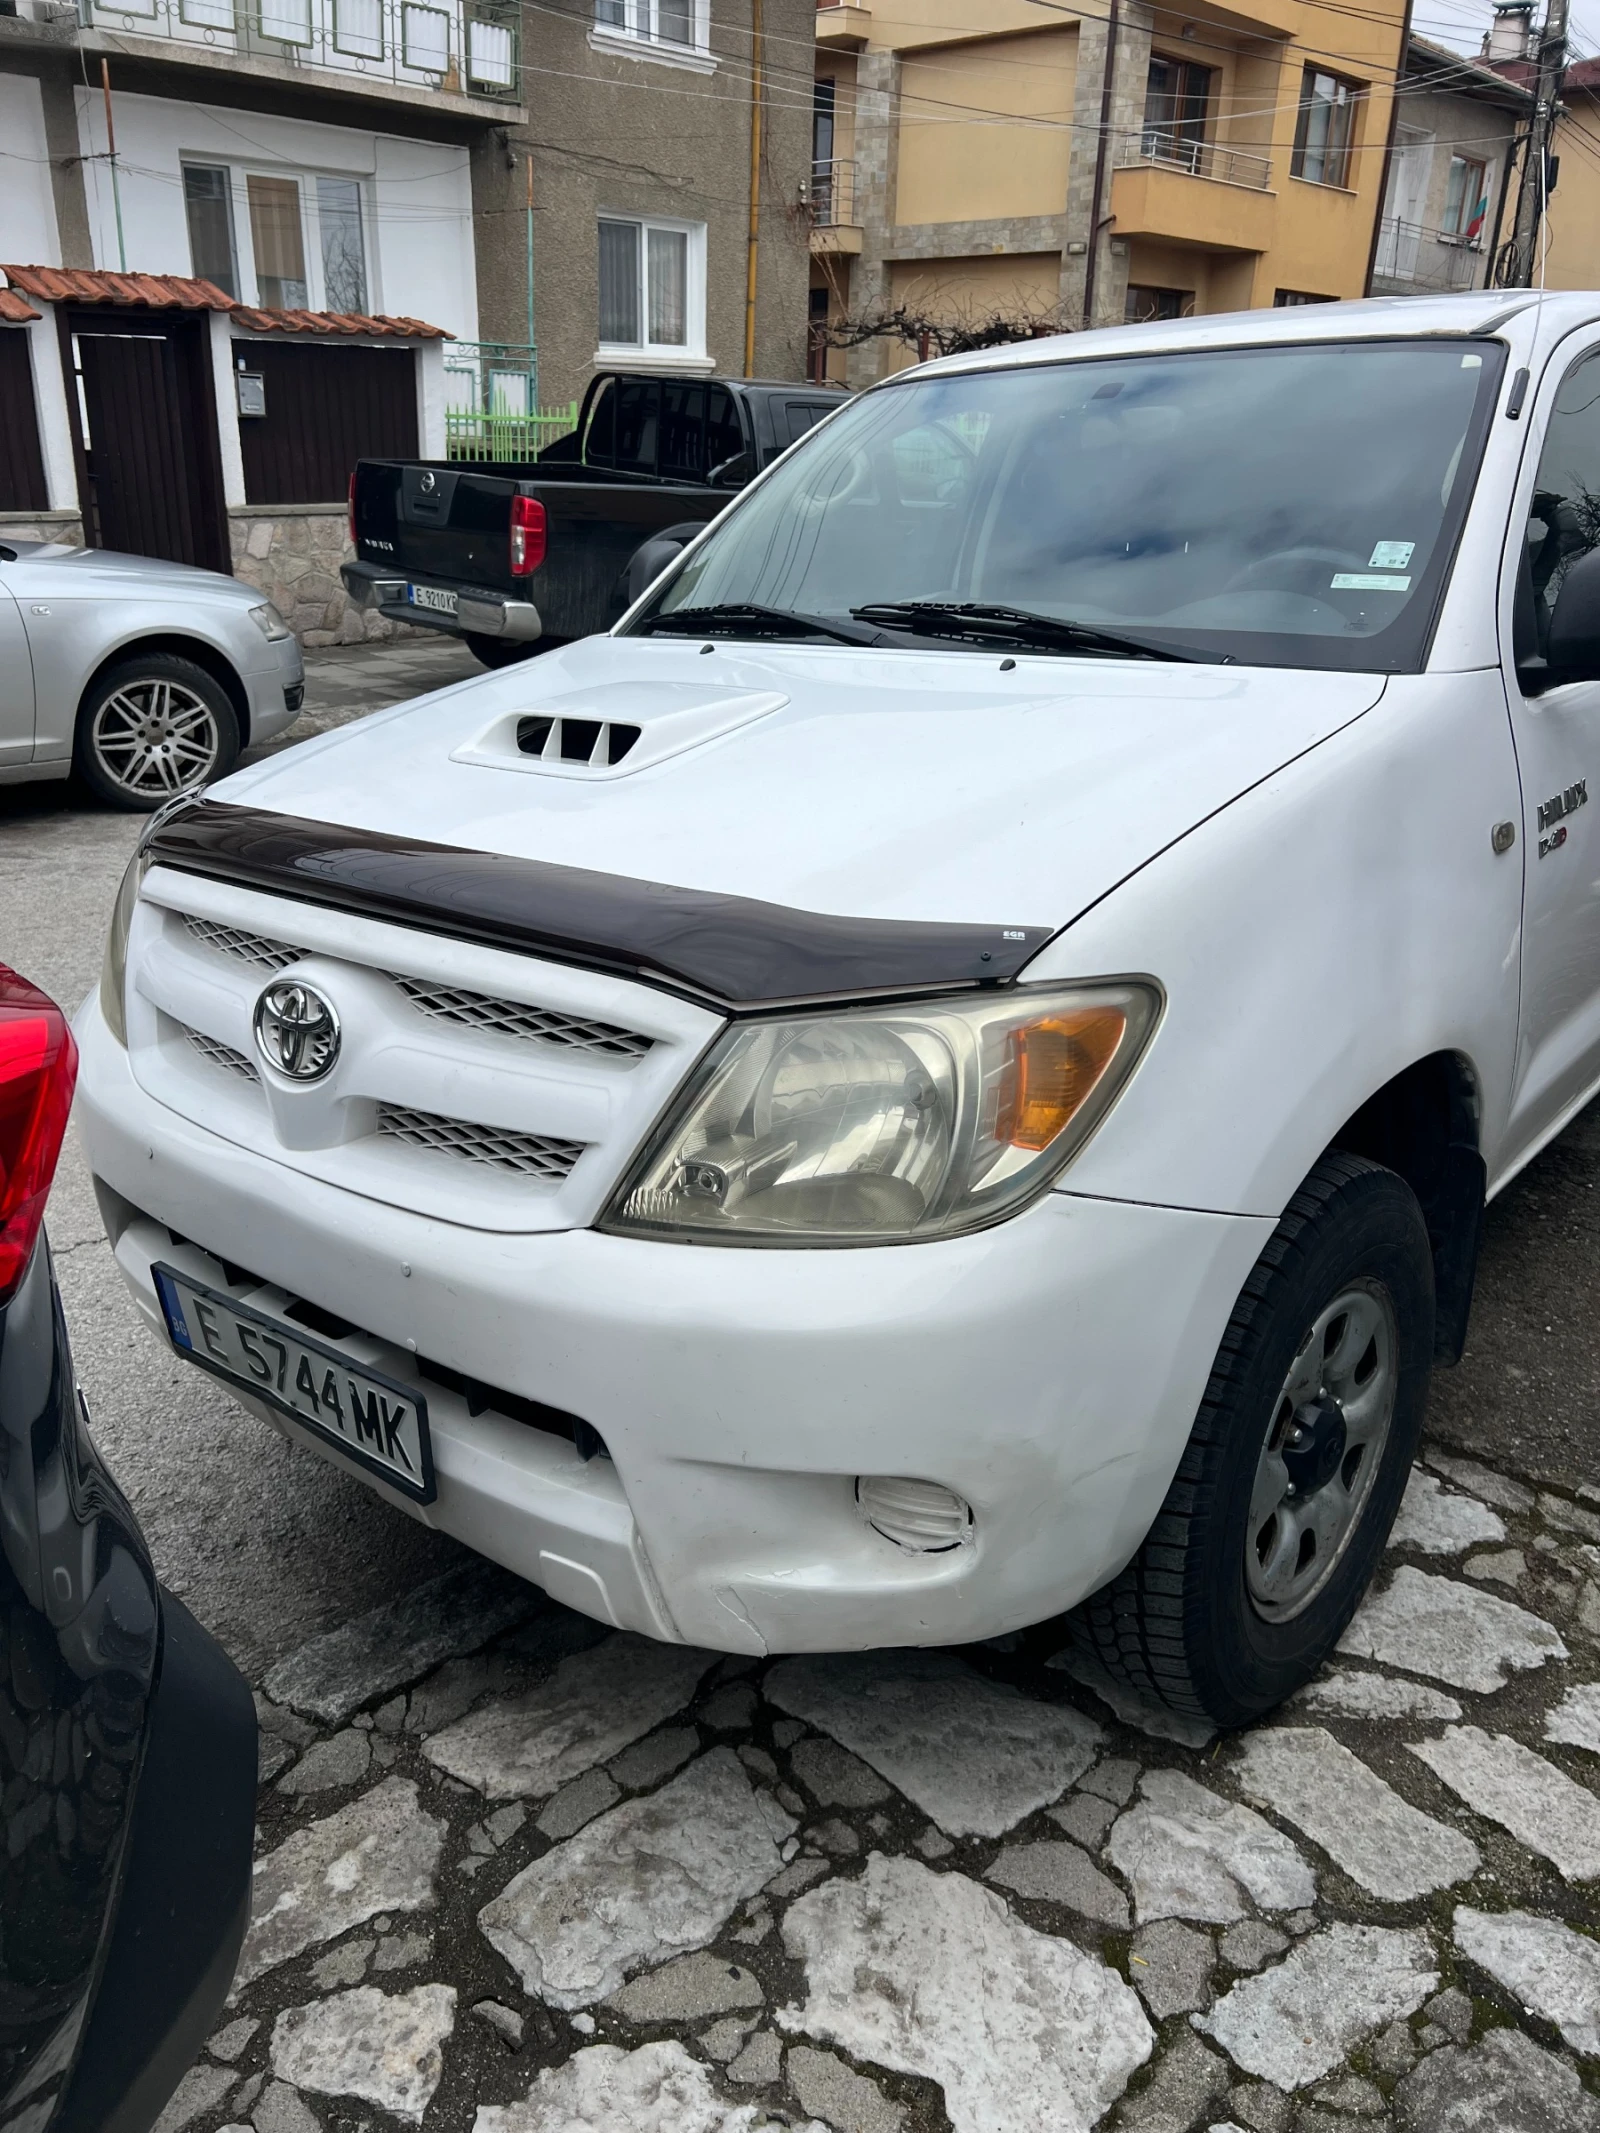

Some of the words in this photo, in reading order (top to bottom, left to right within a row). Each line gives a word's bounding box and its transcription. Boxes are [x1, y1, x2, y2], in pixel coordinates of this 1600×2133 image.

[416, 587, 423, 604] E
[1003, 930, 1026, 938] EGR
[171, 1315, 188, 1337] BG
[193, 1296, 231, 1365] E
